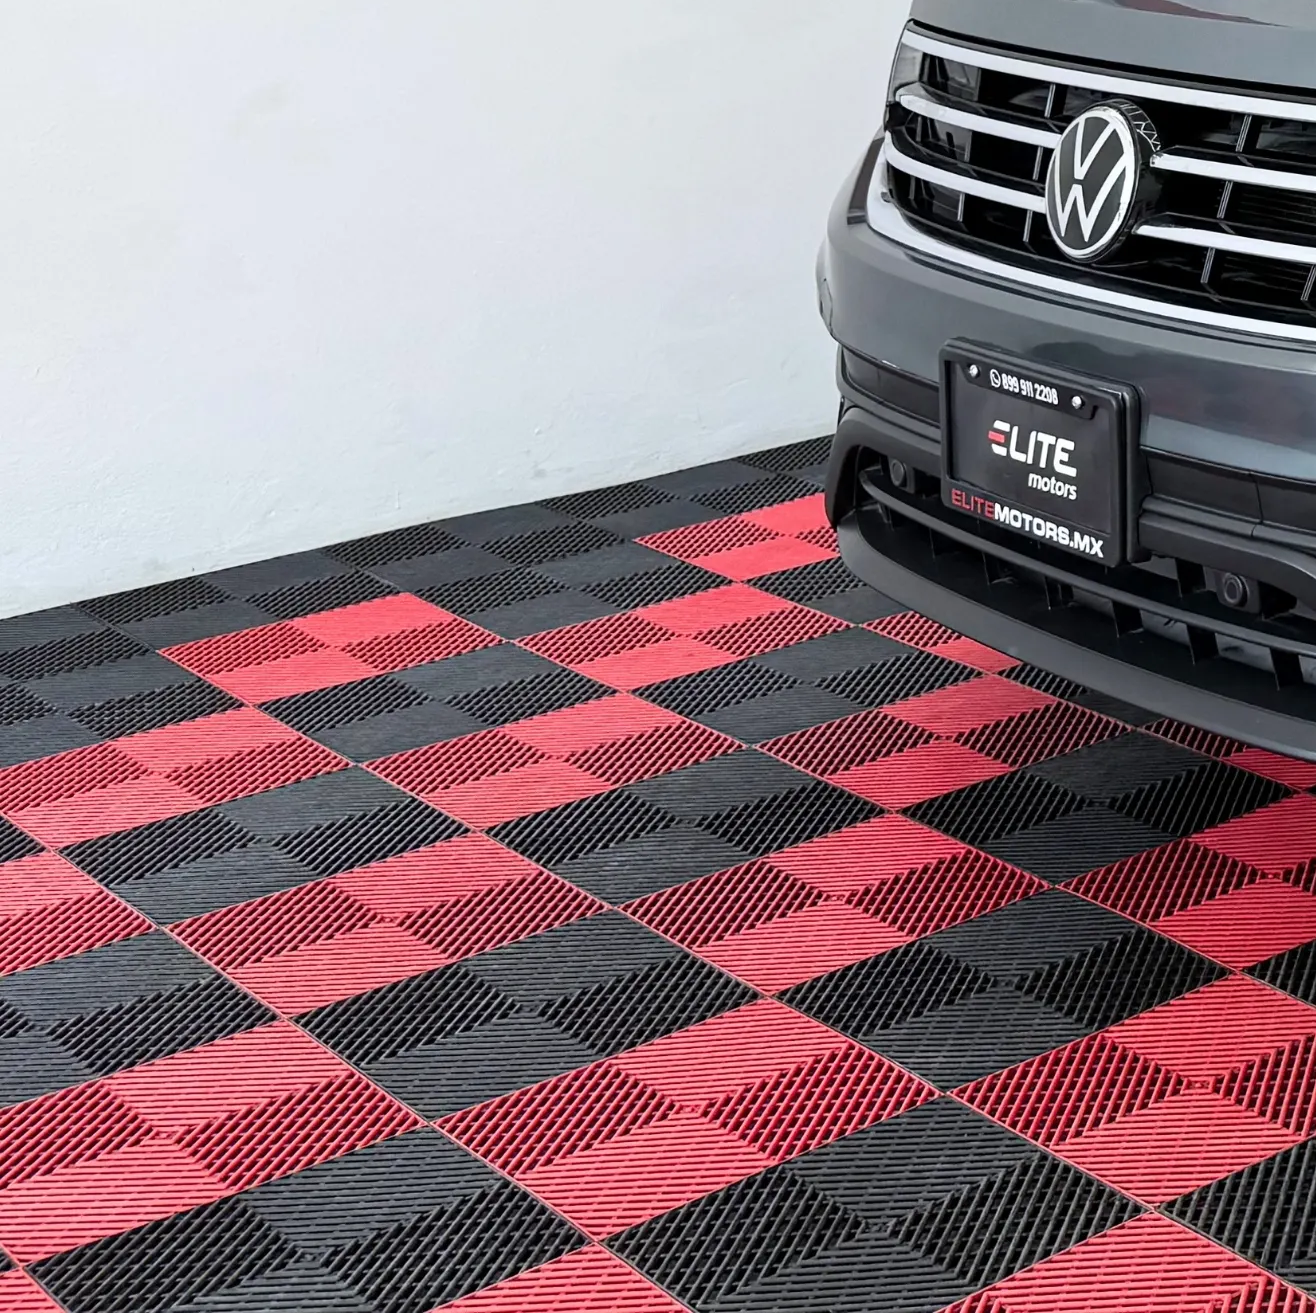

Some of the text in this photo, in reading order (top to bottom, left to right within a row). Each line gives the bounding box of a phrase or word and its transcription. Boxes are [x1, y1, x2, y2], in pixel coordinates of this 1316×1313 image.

[1001, 373, 1059, 405] 899 911 2208
[988, 420, 1078, 477] ELITE
[1028, 472, 1078, 501] motors
